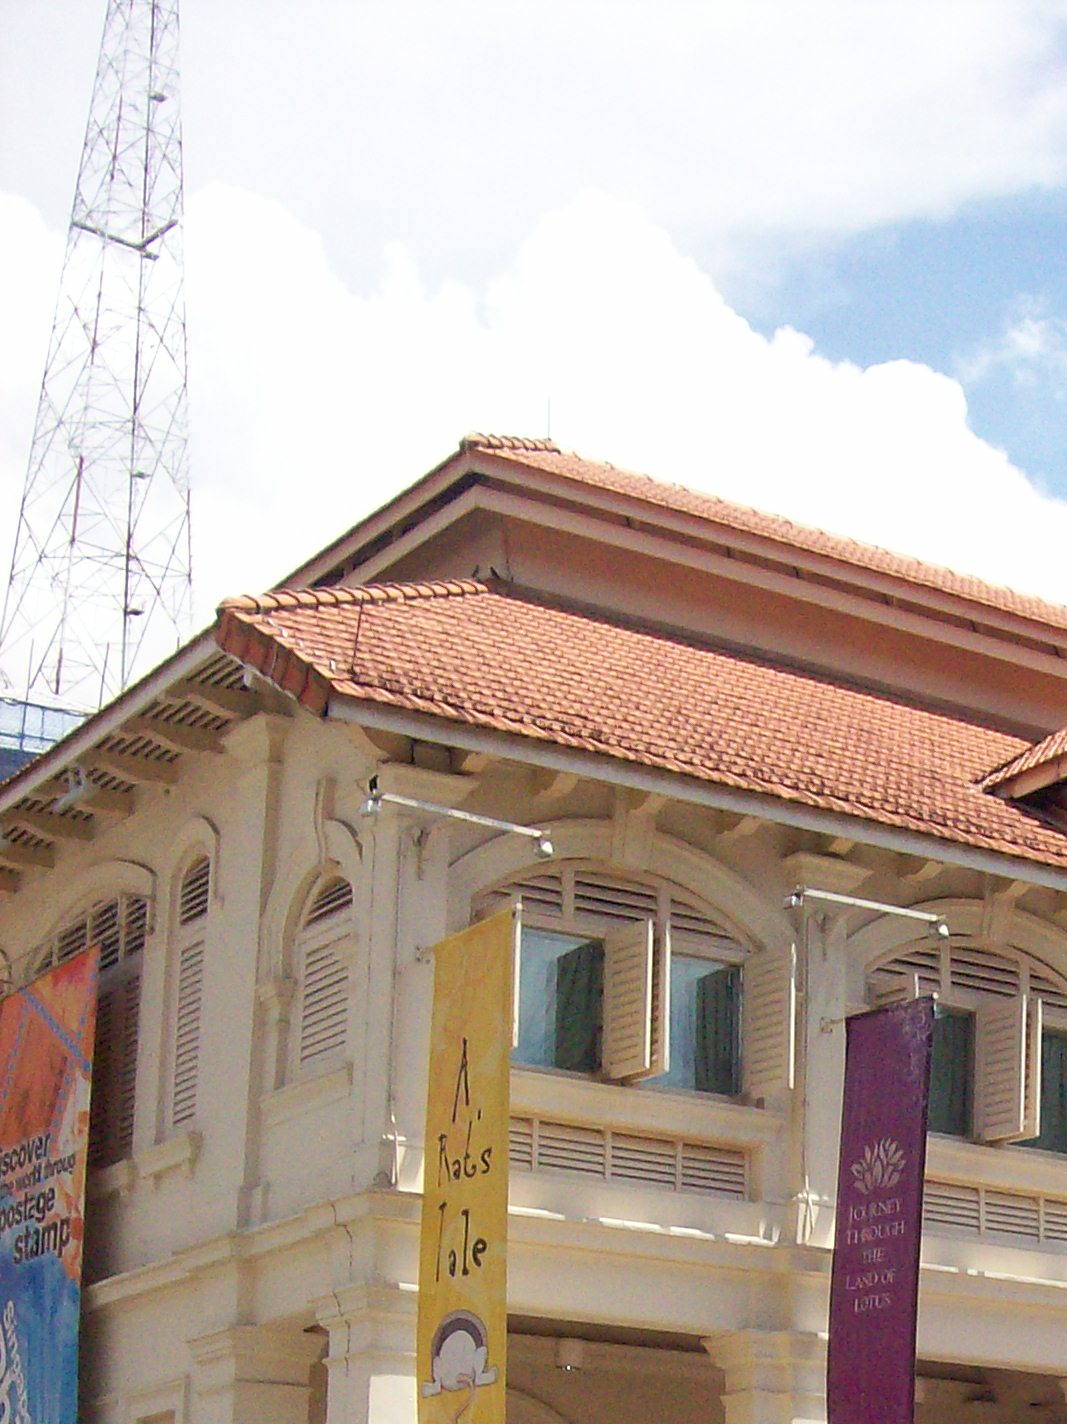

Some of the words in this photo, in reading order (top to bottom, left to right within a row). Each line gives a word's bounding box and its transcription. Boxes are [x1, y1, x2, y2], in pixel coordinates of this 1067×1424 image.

[452, 1037, 470, 1123] A
[437, 1107, 492, 1188] Rat's
[850, 1199, 901, 1221] JOURNEY
[13, 1215, 71, 1265] stamp
[435, 1201, 488, 1283] Tale
[846, 1220, 905, 1246] THROUGH
[861, 1247, 886, 1265] THE
[845, 1270, 879, 1291] LAND
[880, 1268, 897, 1286] OF
[853, 1293, 892, 1314] LOTUS
